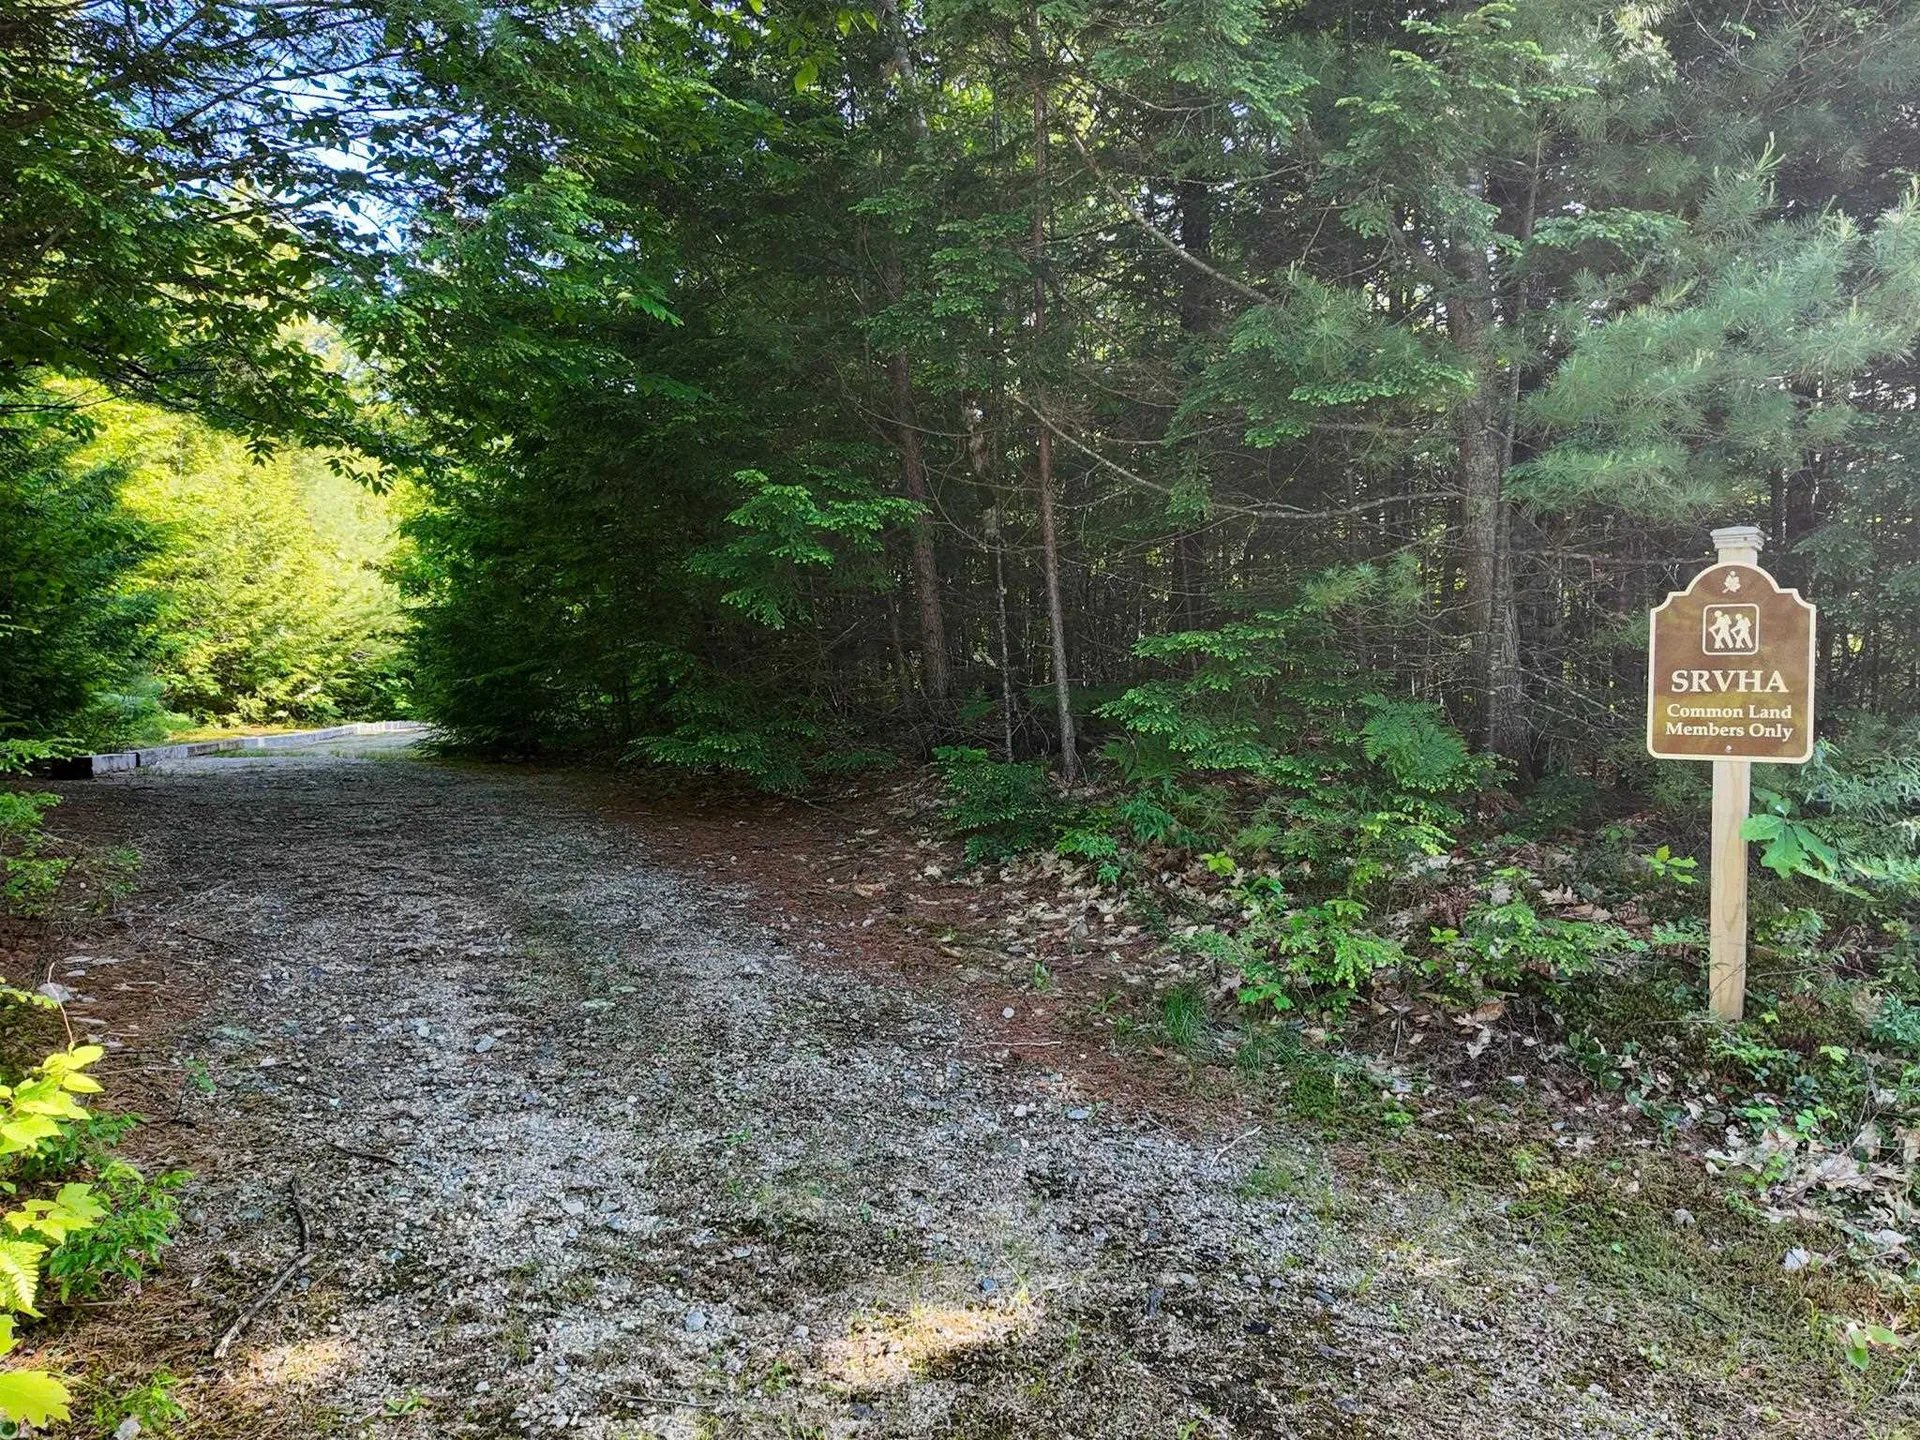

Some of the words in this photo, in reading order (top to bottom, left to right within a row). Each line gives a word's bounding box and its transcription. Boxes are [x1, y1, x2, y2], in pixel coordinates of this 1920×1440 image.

[1671, 670, 1789, 693] SRVHA
[1666, 704, 1743, 718] Common
[1749, 704, 1792, 719] Land
[1665, 722, 1744, 737] Members
[1749, 723, 1793, 742] Only
